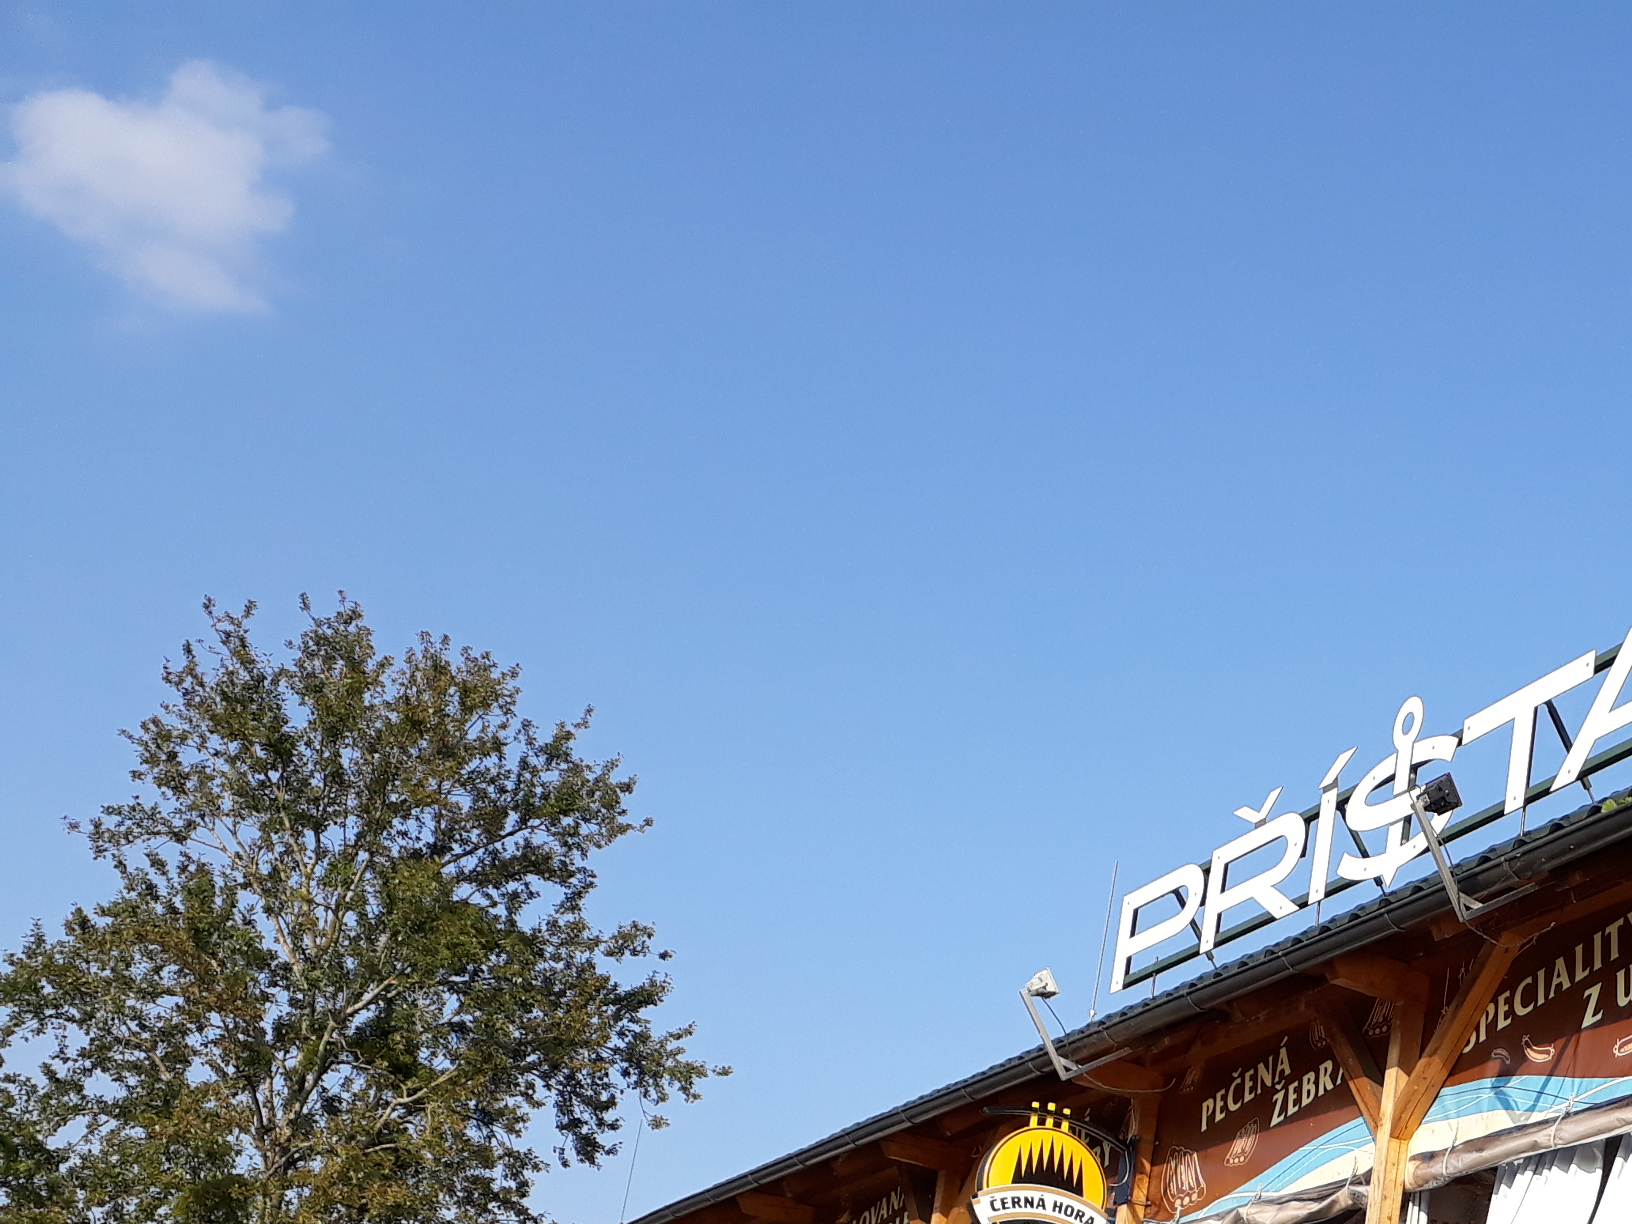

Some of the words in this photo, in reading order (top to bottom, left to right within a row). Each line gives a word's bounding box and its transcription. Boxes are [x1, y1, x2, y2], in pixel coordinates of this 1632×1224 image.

[1580, 981, 1604, 1030] Z
[1200, 1035, 1292, 1133] PEČENÁ
[989, 1194, 1047, 1212] ČERNÁ
